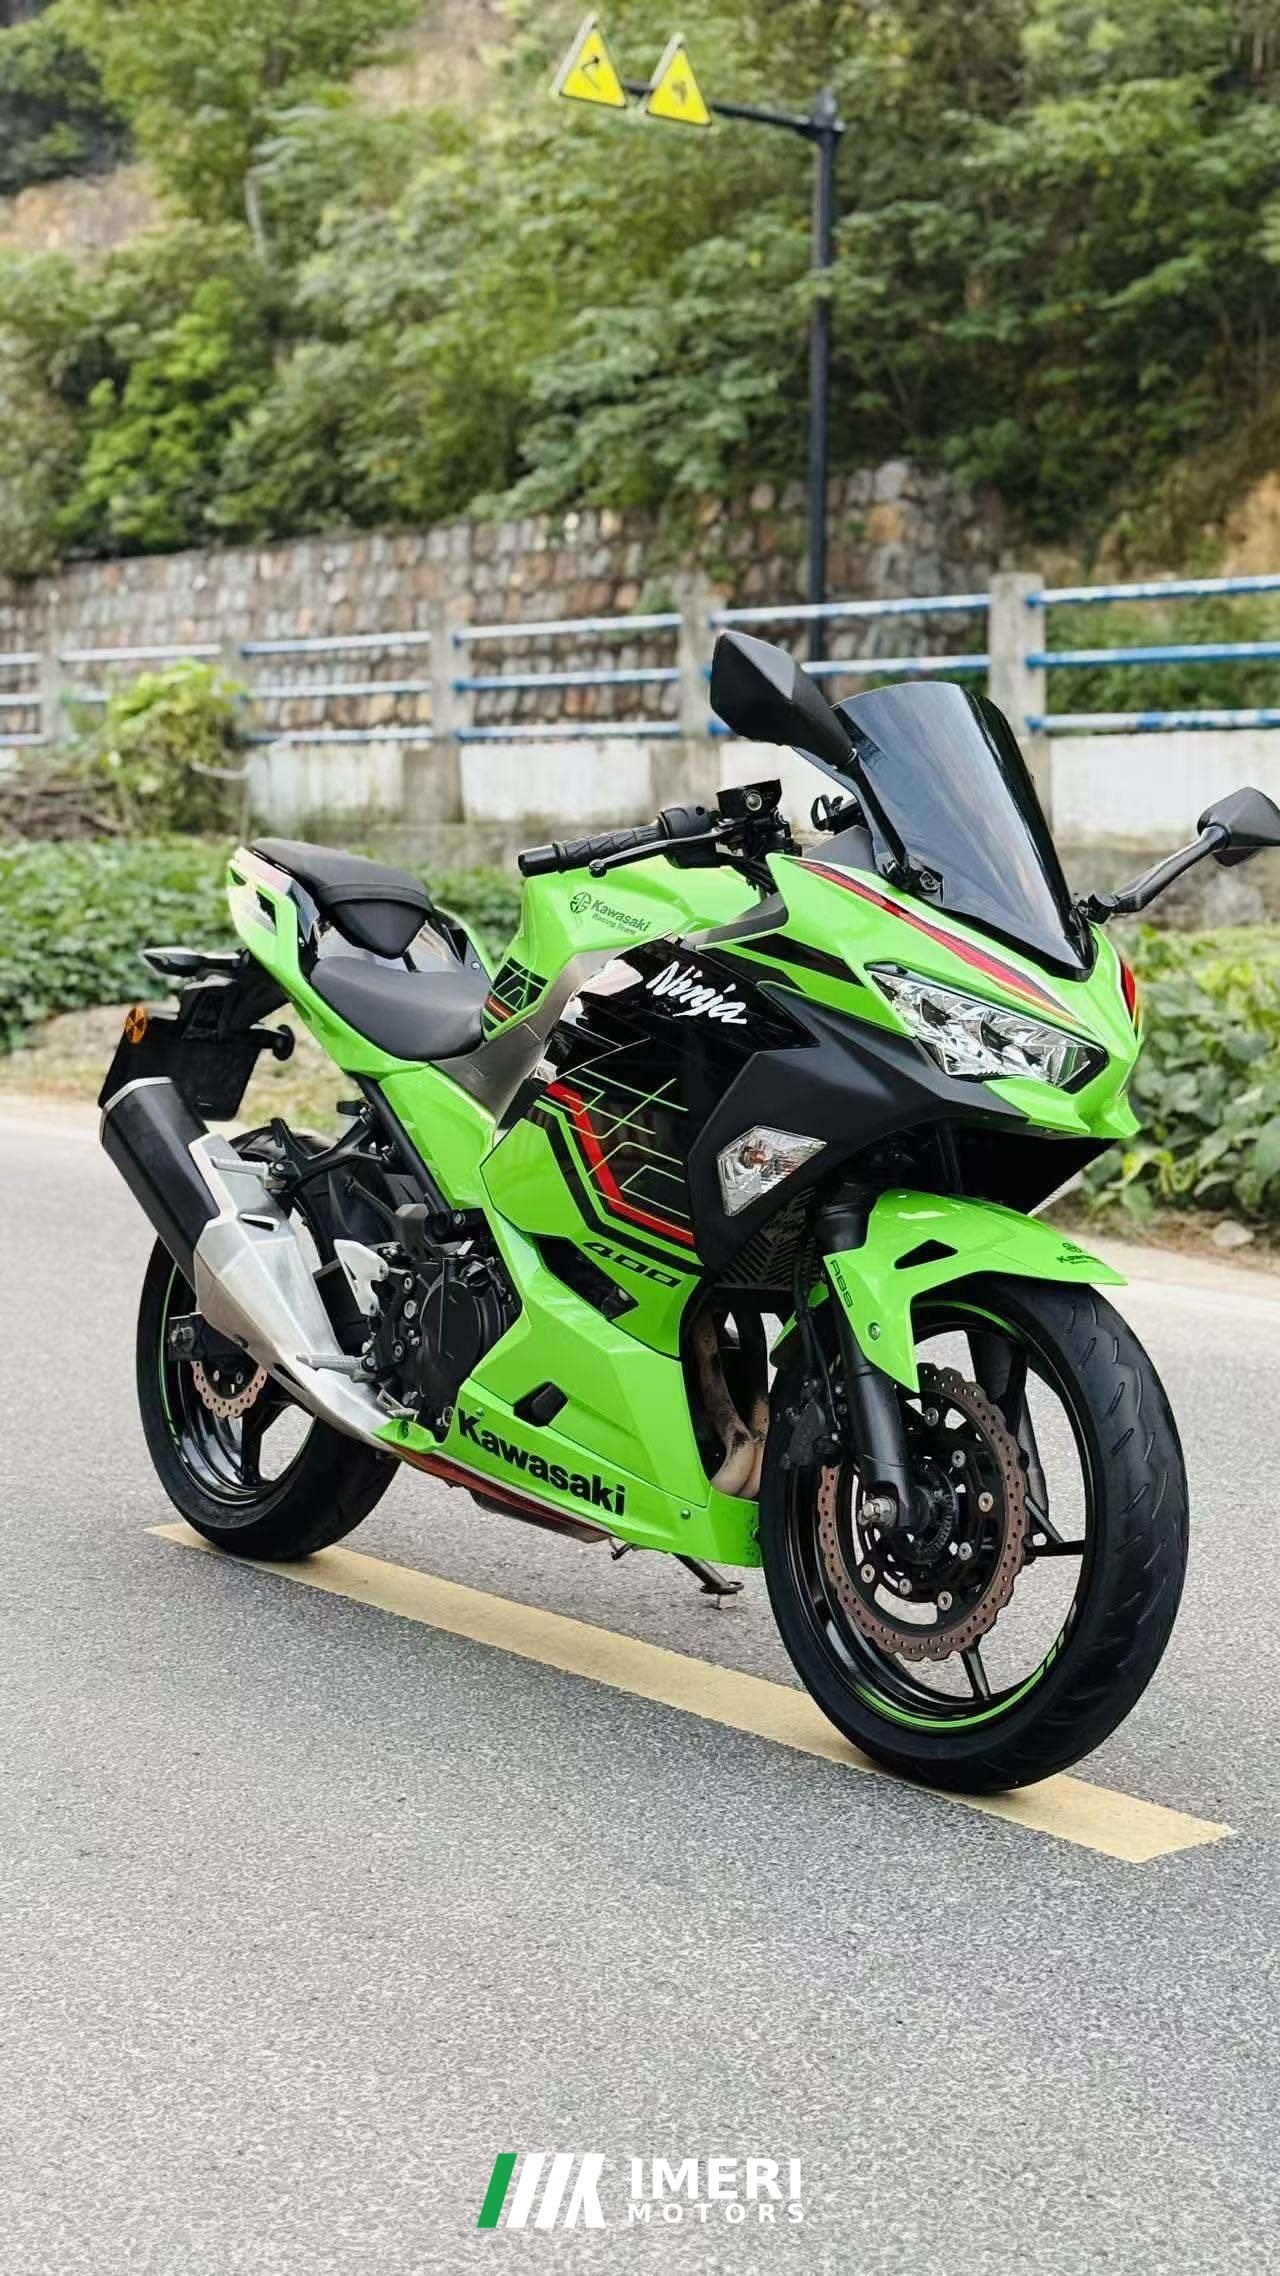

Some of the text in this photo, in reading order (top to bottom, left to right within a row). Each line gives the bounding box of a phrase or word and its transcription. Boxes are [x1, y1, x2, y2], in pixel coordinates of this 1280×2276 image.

[591, 899, 651, 932] Kawasaki
[646, 960, 747, 1025] Ninja
[582, 1241, 682, 1288] 400
[829, 1260, 855, 1308] ABS
[458, 1408, 626, 1516] Kawasaki
